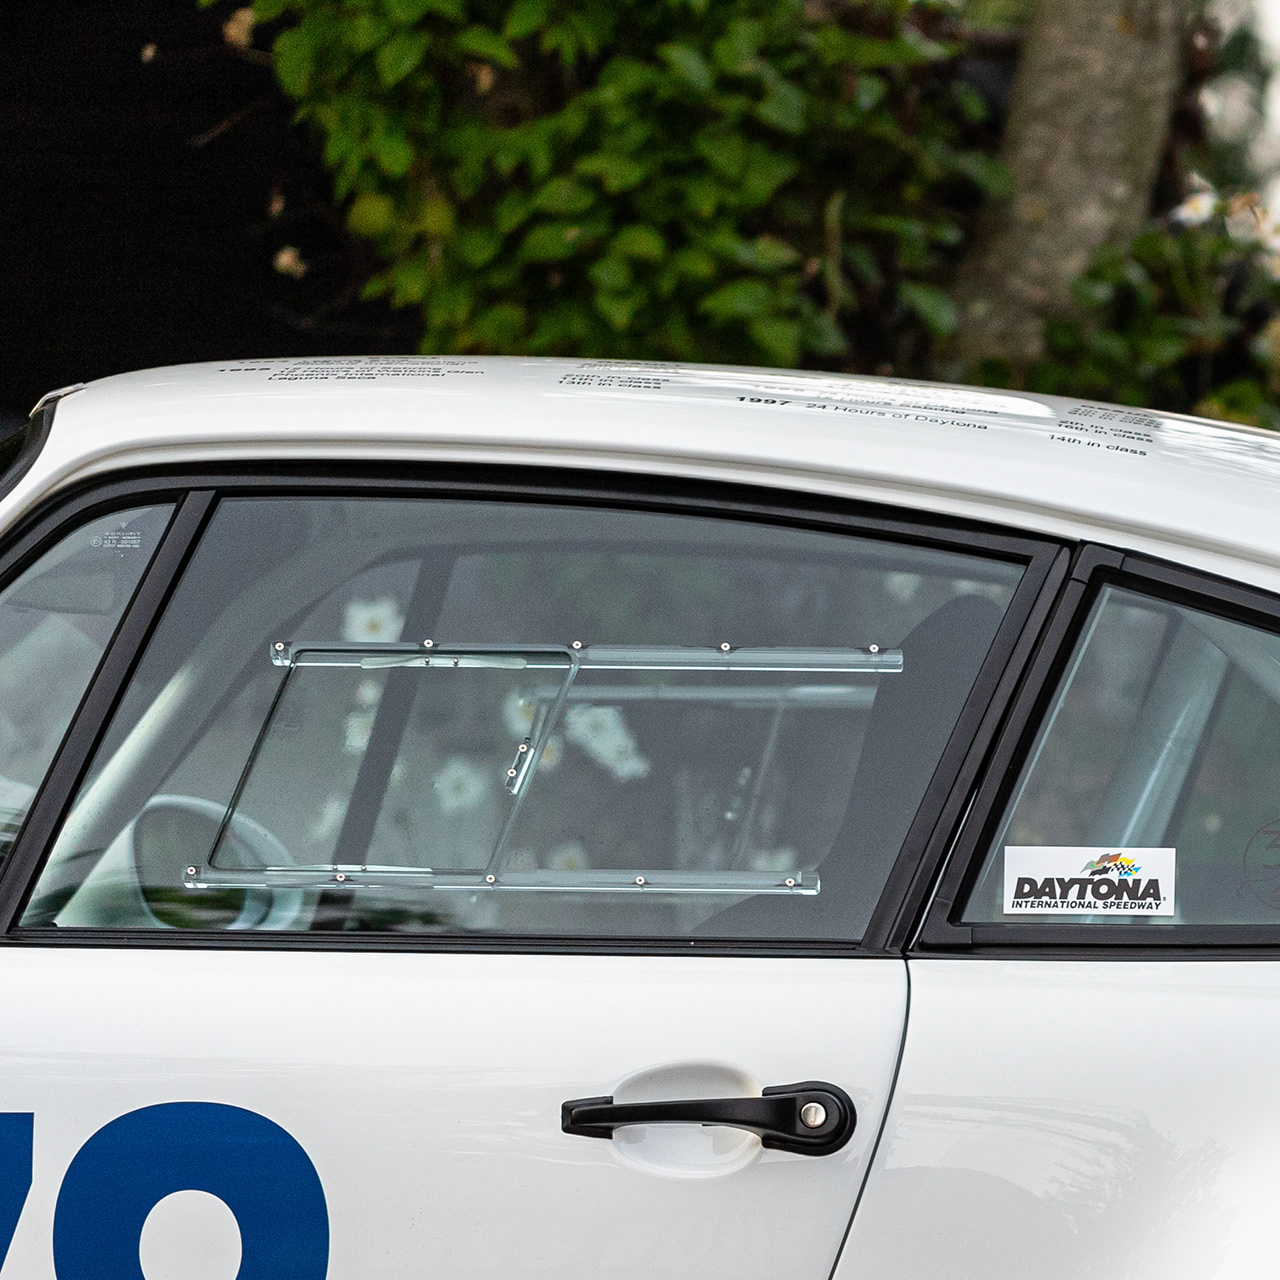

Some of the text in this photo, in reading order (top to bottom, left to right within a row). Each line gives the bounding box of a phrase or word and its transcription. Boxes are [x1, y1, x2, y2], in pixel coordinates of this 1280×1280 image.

[736, 396, 792, 406] 1997
[834, 406, 886, 416] Hours
[915, 416, 988, 430] Daytona
[1049, 434, 1147, 456] 14th in class
[1013, 877, 1162, 901] DAYTONA
[1012, 900, 1162, 910] INTERNATIONAL SPEEDWAY
